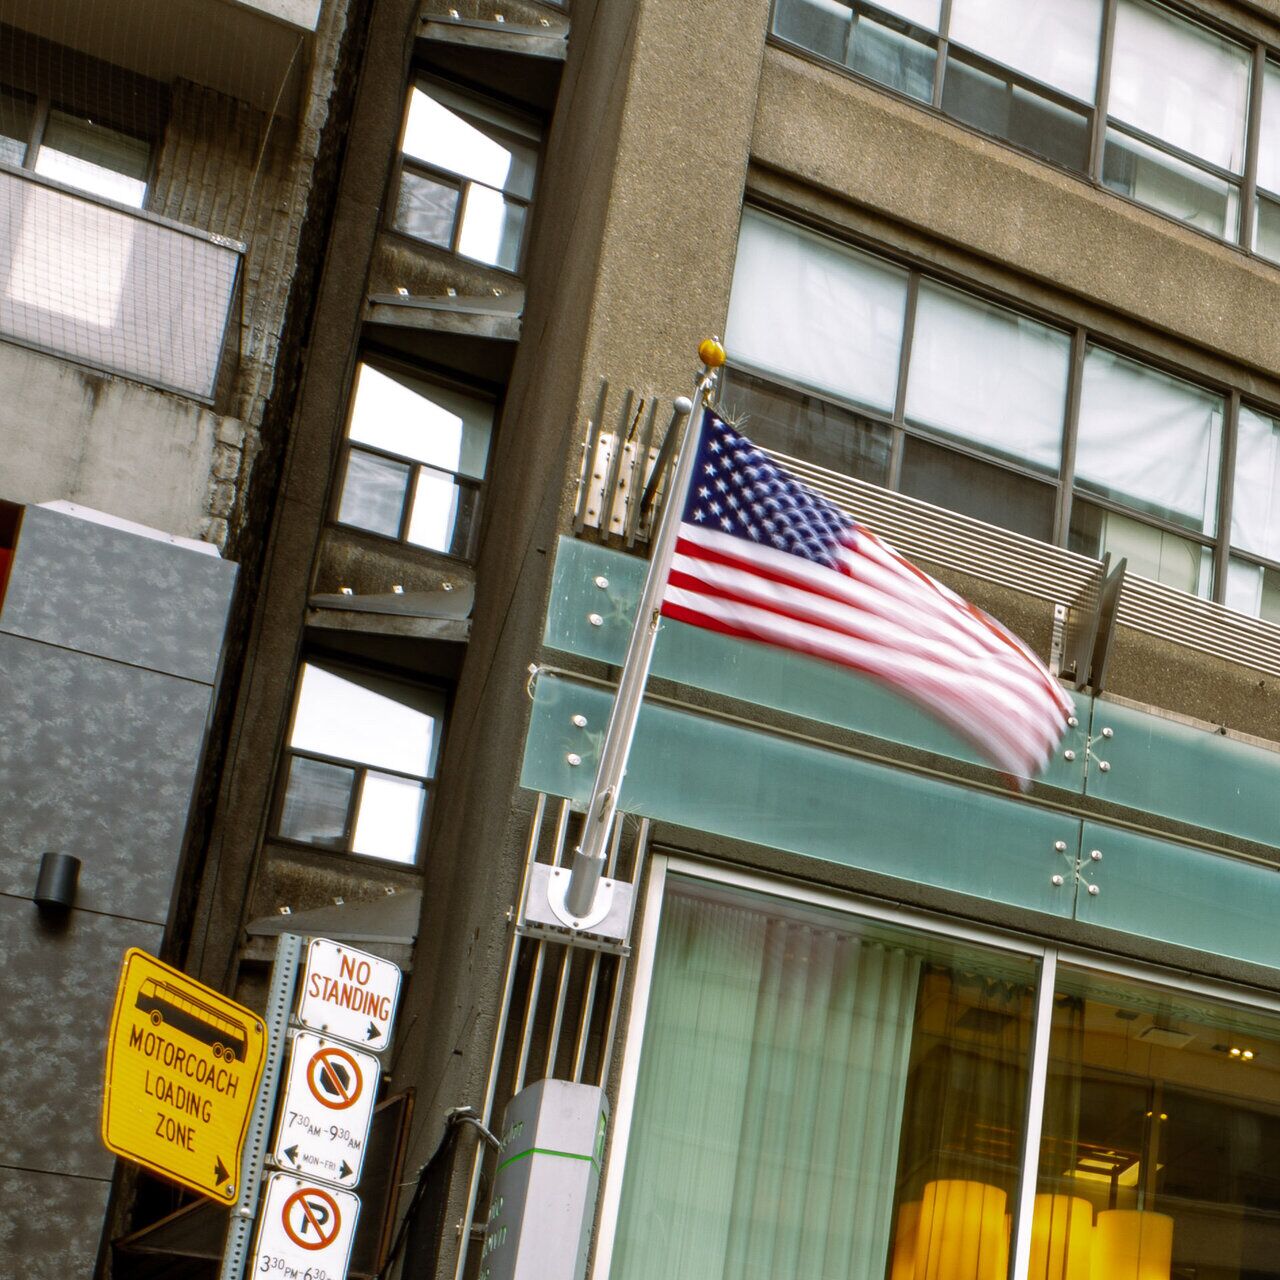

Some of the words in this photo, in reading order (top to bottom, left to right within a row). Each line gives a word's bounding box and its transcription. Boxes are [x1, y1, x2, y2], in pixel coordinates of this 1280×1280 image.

[339, 954, 371, 986] NO
[308, 973, 391, 1021] STANDING
[129, 1024, 239, 1098] MOTORCOACH
[144, 1069, 212, 1123] LOADING
[155, 1112, 196, 1152] ZONE
